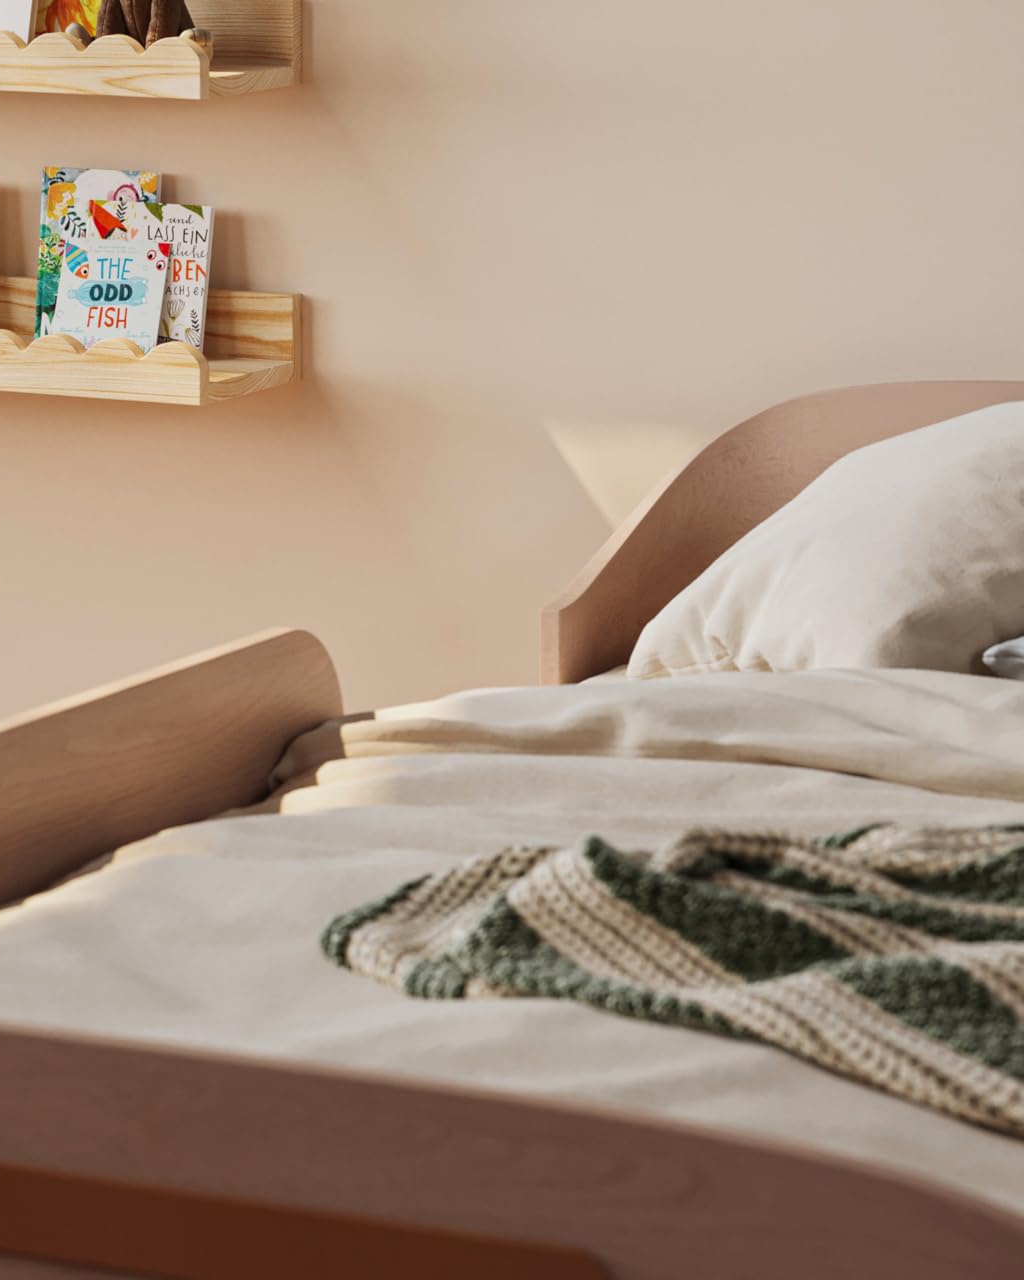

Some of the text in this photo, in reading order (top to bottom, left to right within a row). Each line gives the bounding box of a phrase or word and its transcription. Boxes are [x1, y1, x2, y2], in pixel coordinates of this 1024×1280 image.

[182, 227, 208, 245] EIN
[96, 257, 134, 280] THE
[89, 283, 133, 302] ODD
[86, 306, 128, 329] FISH
